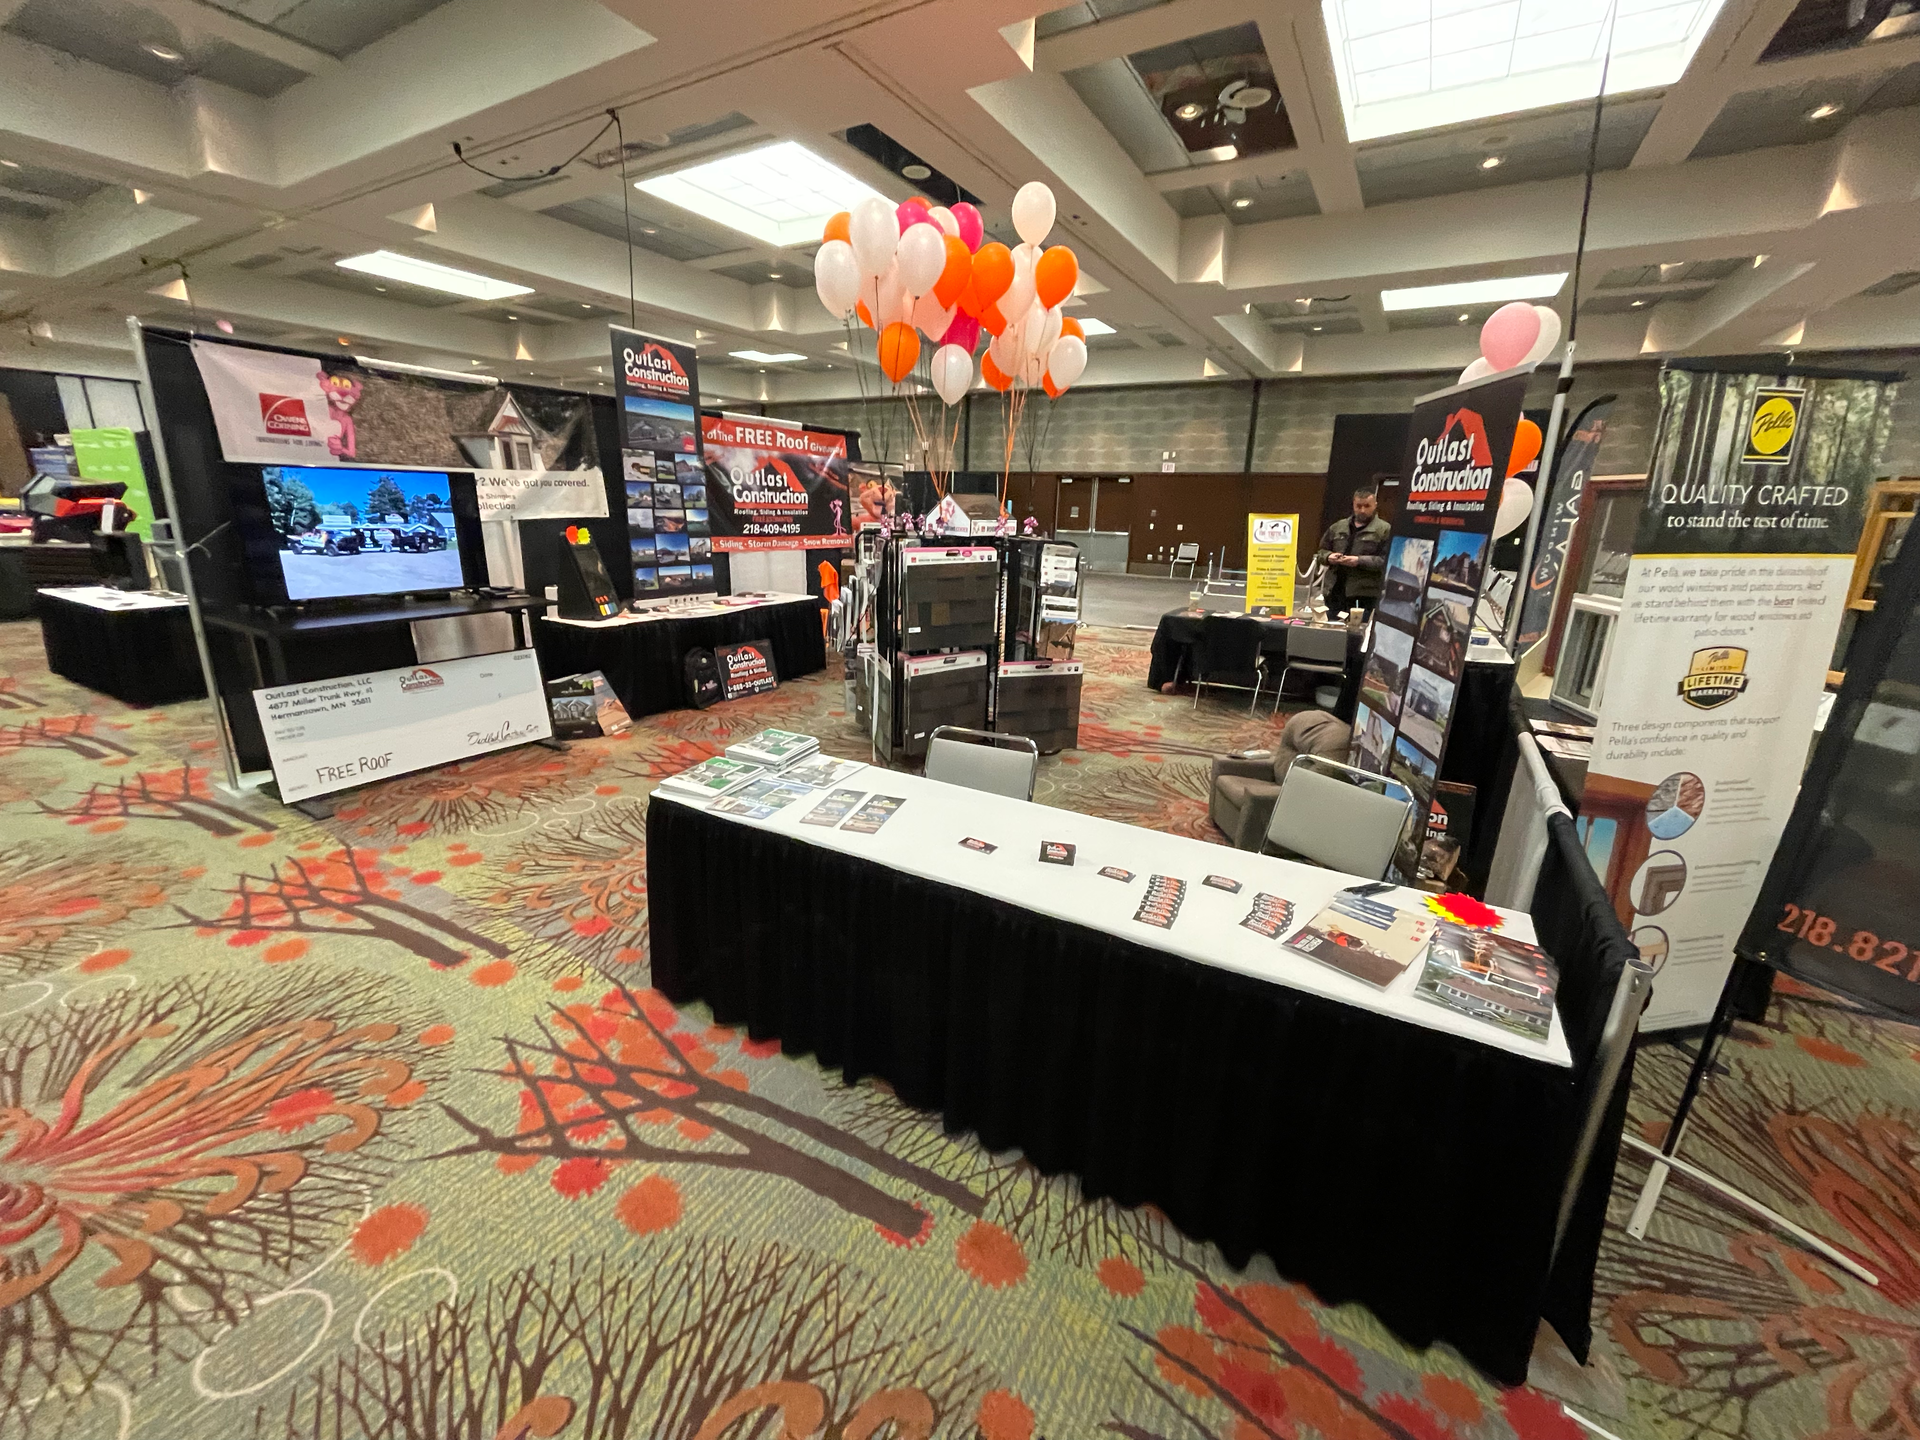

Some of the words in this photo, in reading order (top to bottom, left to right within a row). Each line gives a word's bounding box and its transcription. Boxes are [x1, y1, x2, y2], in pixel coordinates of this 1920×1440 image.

[623, 347, 671, 370] OutLast
[625, 362, 689, 387] Construction
[267, 420, 310, 432] CORNING
[1754, 410, 1793, 437] Pella
[707, 430, 717, 440] of
[717, 430, 733, 442] The
[736, 426, 772, 447] FREE
[776, 432, 808, 450] Roof
[1417, 433, 1475, 465] OutLast
[489, 477, 520, 487] We've
[523, 479, 539, 489] got
[540, 480, 552, 489] you
[553, 479, 590, 487] covered.
[730, 466, 787, 487] OutLast
[1411, 460, 1493, 493] Construction
[733, 484, 808, 504] Construction
[1661, 484, 1753, 505] QUALITY
[1757, 485, 1849, 506] CRAFTED
[1446, 501, 1452, 511] &
[1667, 515, 1685, 528] to
[1686, 510, 1726, 528] stand
[1728, 510, 1751, 528] the
[1753, 514, 1777, 528] test
[1780, 511, 1799, 528] of
[1798, 513, 1829, 528] time.
[720, 540, 743, 549] Siding
[748, 540, 771, 548] Storm
[772, 539, 798, 548] Damage
[803, 538, 820, 546] Snow
[822, 537, 852, 545] Removal
[1720, 566, 1746, 579] pride
[1638, 585, 1655, 593] our
[1659, 582, 1684, 593] wood
[1686, 582, 1727, 592] windows
[1645, 598, 1673, 608] stand
[1674, 597, 1707, 607] behind
[1774, 596, 1794, 606] best
[1634, 613, 1670, 623] lifetime
[1672, 613, 1712, 624] warranty
[1714, 611, 1728, 621] for
[1730, 611, 1756, 621] wood
[727, 652, 755, 663] OutLast
[729, 657, 766, 670] Construction
[265, 689, 299, 700] OutLast
[302, 681, 356, 695] Construction,
[357, 677, 372, 685] LLC
[1687, 675, 1740, 687] LIFETIME
[318, 692, 341, 702] Trunk
[1690, 688, 1733, 698] WARRANTY
[271, 705, 329, 720] Hermantown,
[331, 701, 347, 710] MN
[1612, 722, 1640, 732] Three
[1642, 720, 1672, 732] design
[1673, 717, 1727, 730] components
[1729, 716, 1746, 726] that
[1747, 715, 1781, 727] support
[1608, 735, 1638, 746] Pella's
[1639, 733, 1688, 745] confidence
[1690, 733, 1698, 742] in
[1700, 731, 1729, 743] quality
[1730, 730, 1747, 739] and
[1605, 749, 1648, 760] durability
[316, 763, 357, 784] FREE
[358, 752, 393, 773] ROOF
